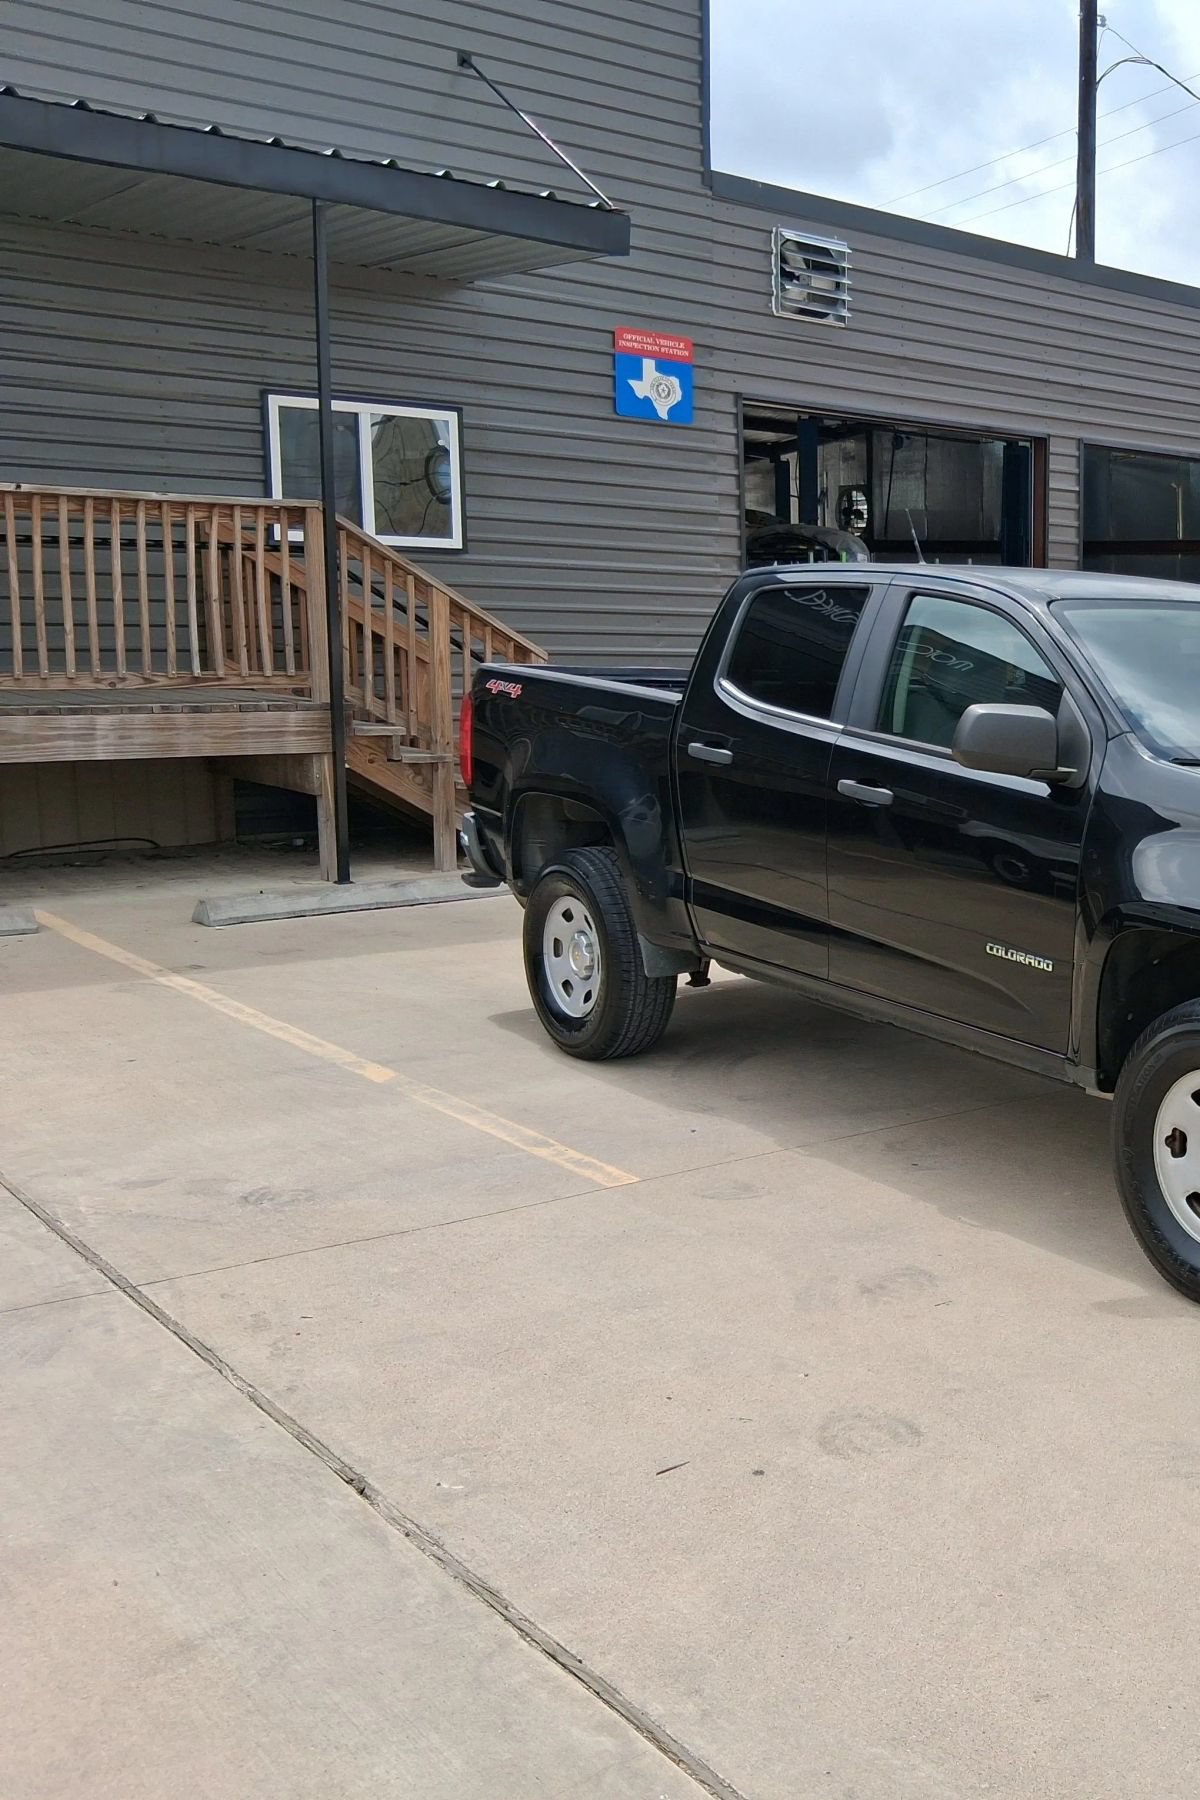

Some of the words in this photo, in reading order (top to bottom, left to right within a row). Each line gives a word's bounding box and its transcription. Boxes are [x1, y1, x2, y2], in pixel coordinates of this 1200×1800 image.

[619, 340, 660, 352] INSPECTION
[660, 347, 689, 357] STATION
[623, 333, 655, 344] OFFICIAL
[656, 338, 685, 349] VEHICLE
[986, 942, 1053, 972] COLORADO
